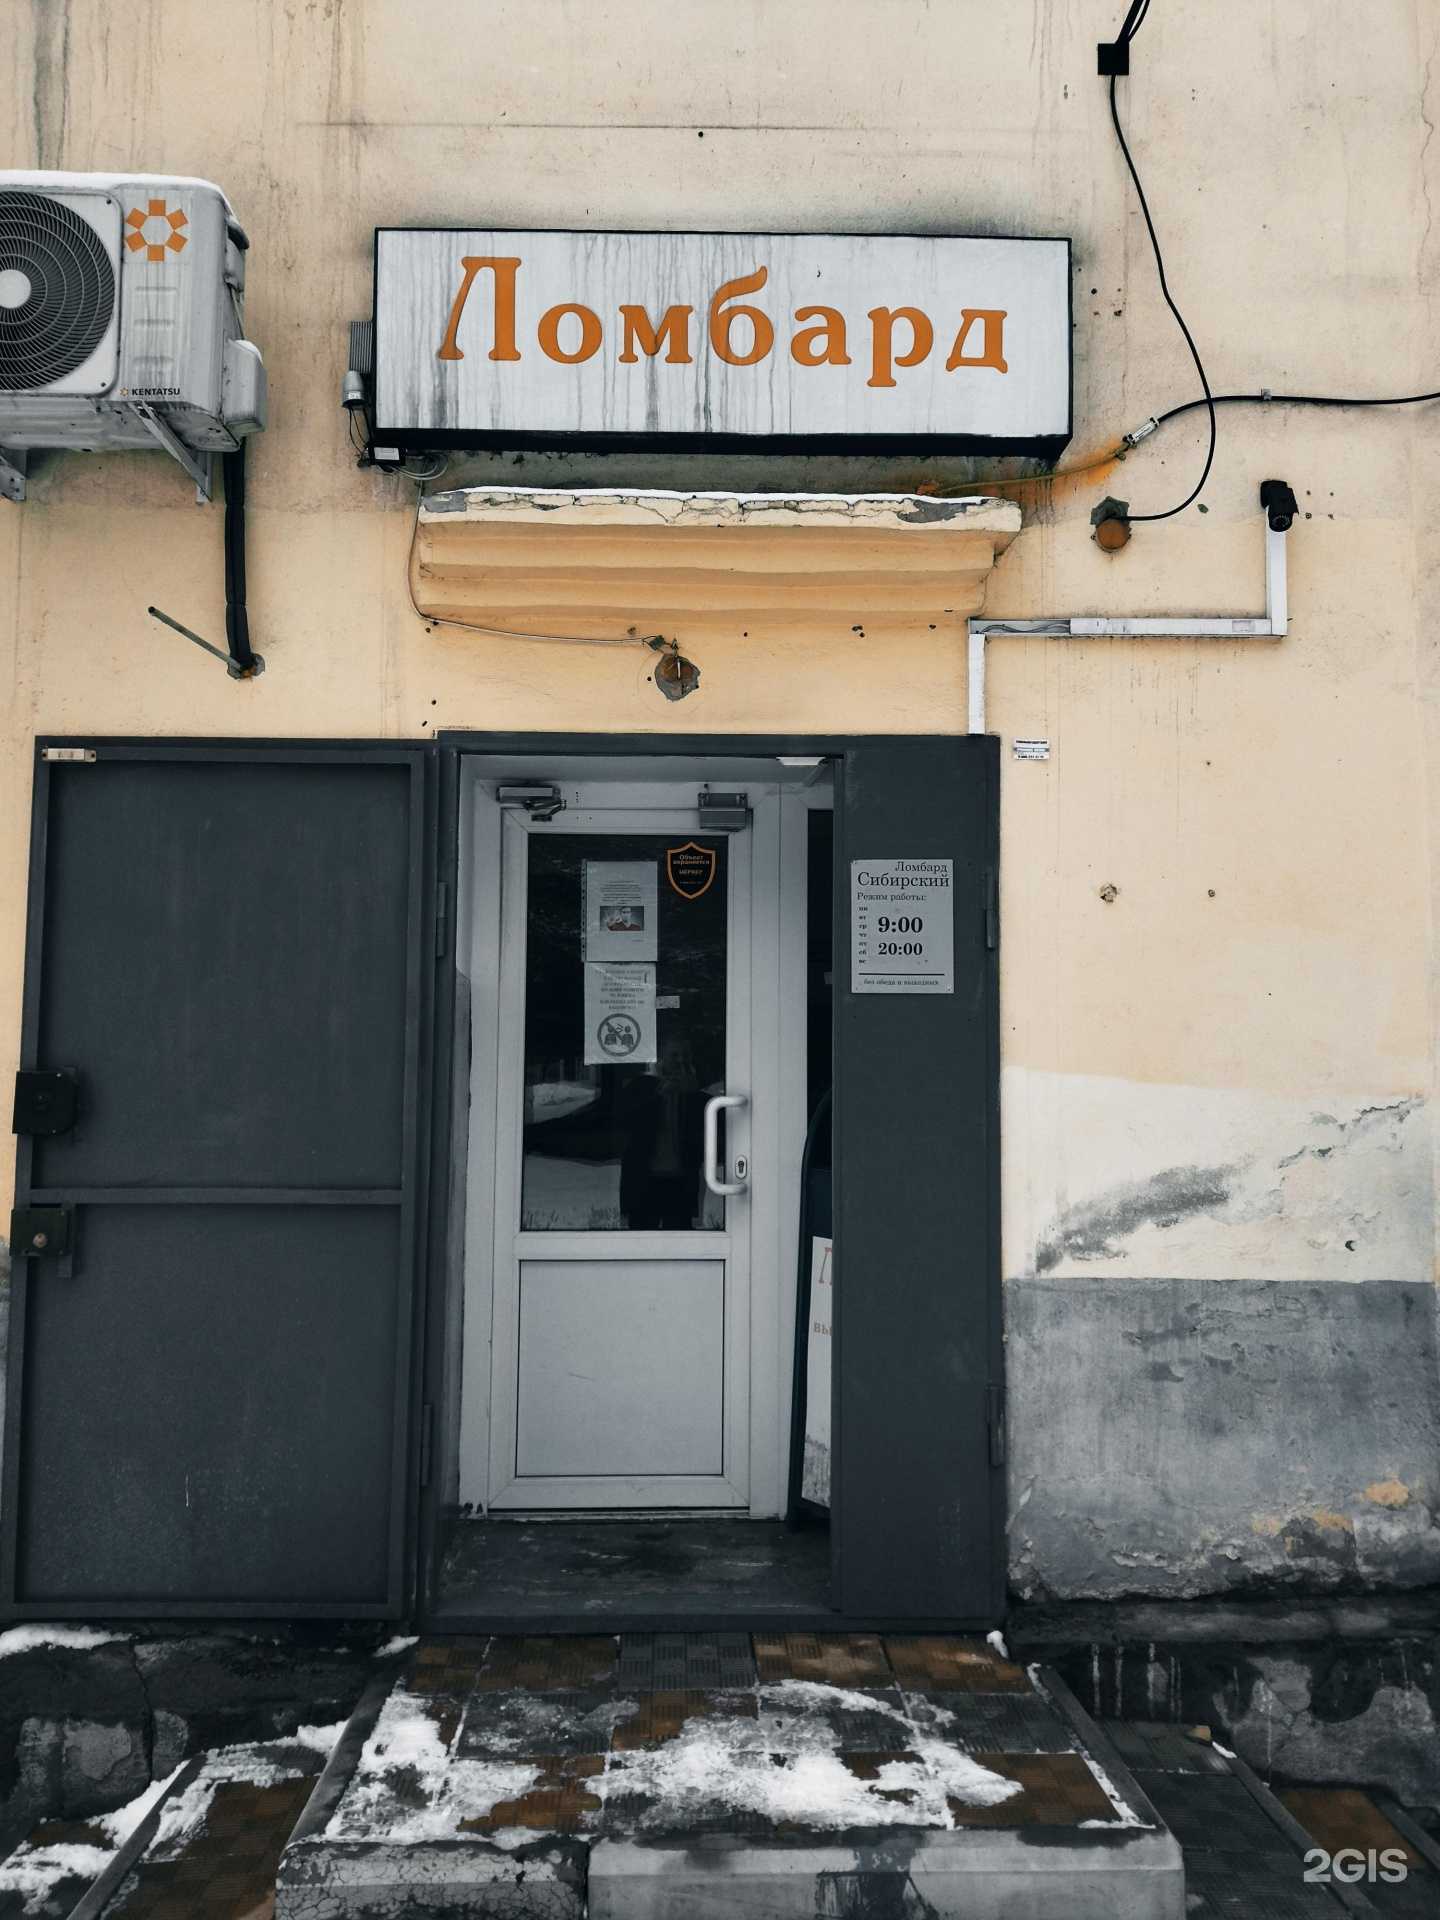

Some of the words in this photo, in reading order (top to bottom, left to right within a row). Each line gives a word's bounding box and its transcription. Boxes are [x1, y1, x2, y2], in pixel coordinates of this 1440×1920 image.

[438, 256, 1009, 388] Ломбард
[131, 388, 181, 396] KENTATSU
[895, 861, 948, 874] Ломбард
[857, 872, 950, 889] Сибирский
[857, 892, 888, 901] Режим
[890, 892, 927, 902] работы:
[878, 916, 923, 933] 9:00
[878, 942, 923, 956] 20:00
